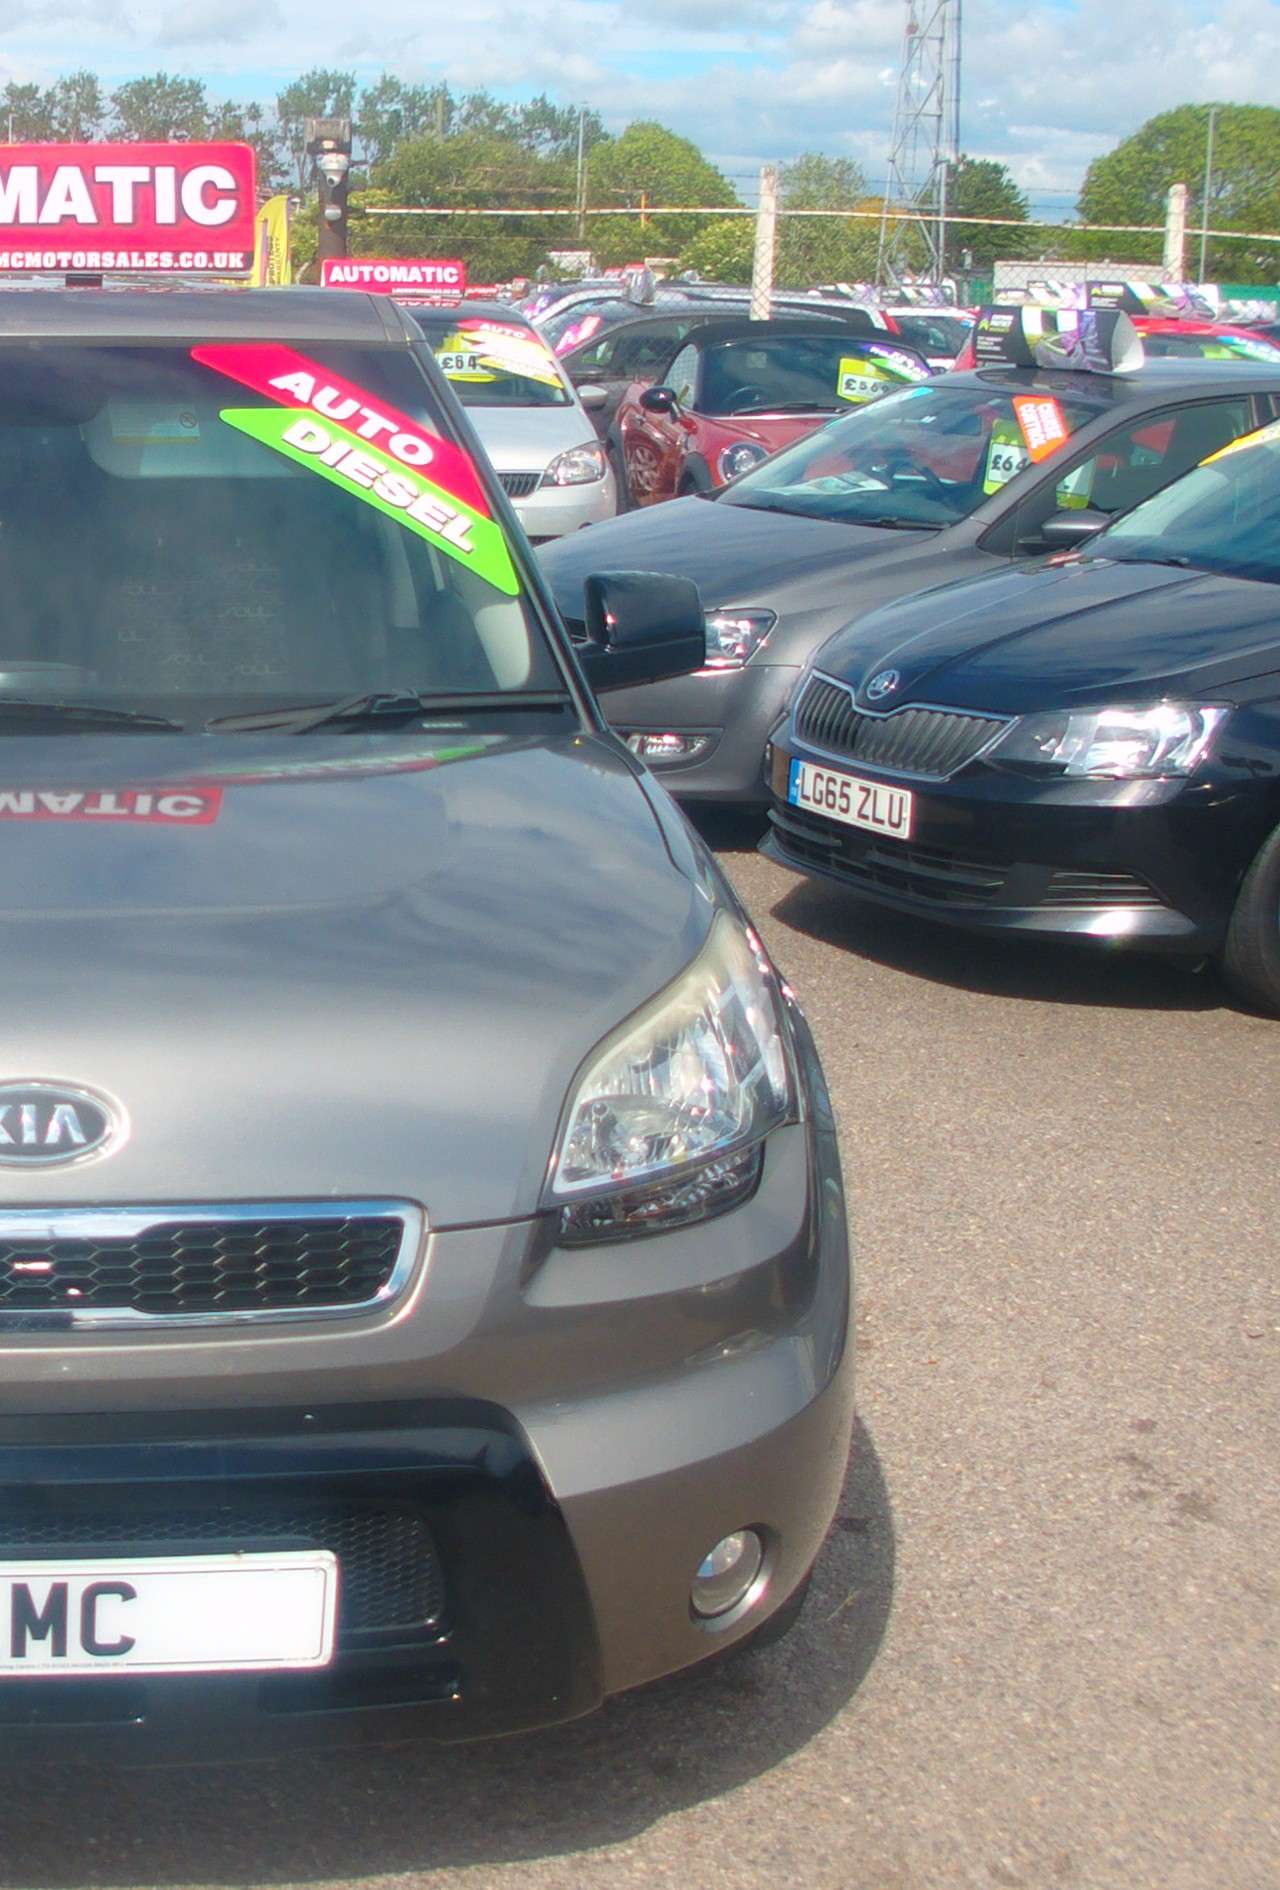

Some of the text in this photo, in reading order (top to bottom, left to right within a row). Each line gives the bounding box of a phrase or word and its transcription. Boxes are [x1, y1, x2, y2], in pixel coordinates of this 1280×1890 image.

[329, 265, 459, 283] AUTOMATIC
[268, 371, 434, 465] AUTO
[282, 418, 474, 554] DIESEL
[799, 767, 905, 830] LG65 ZLU
